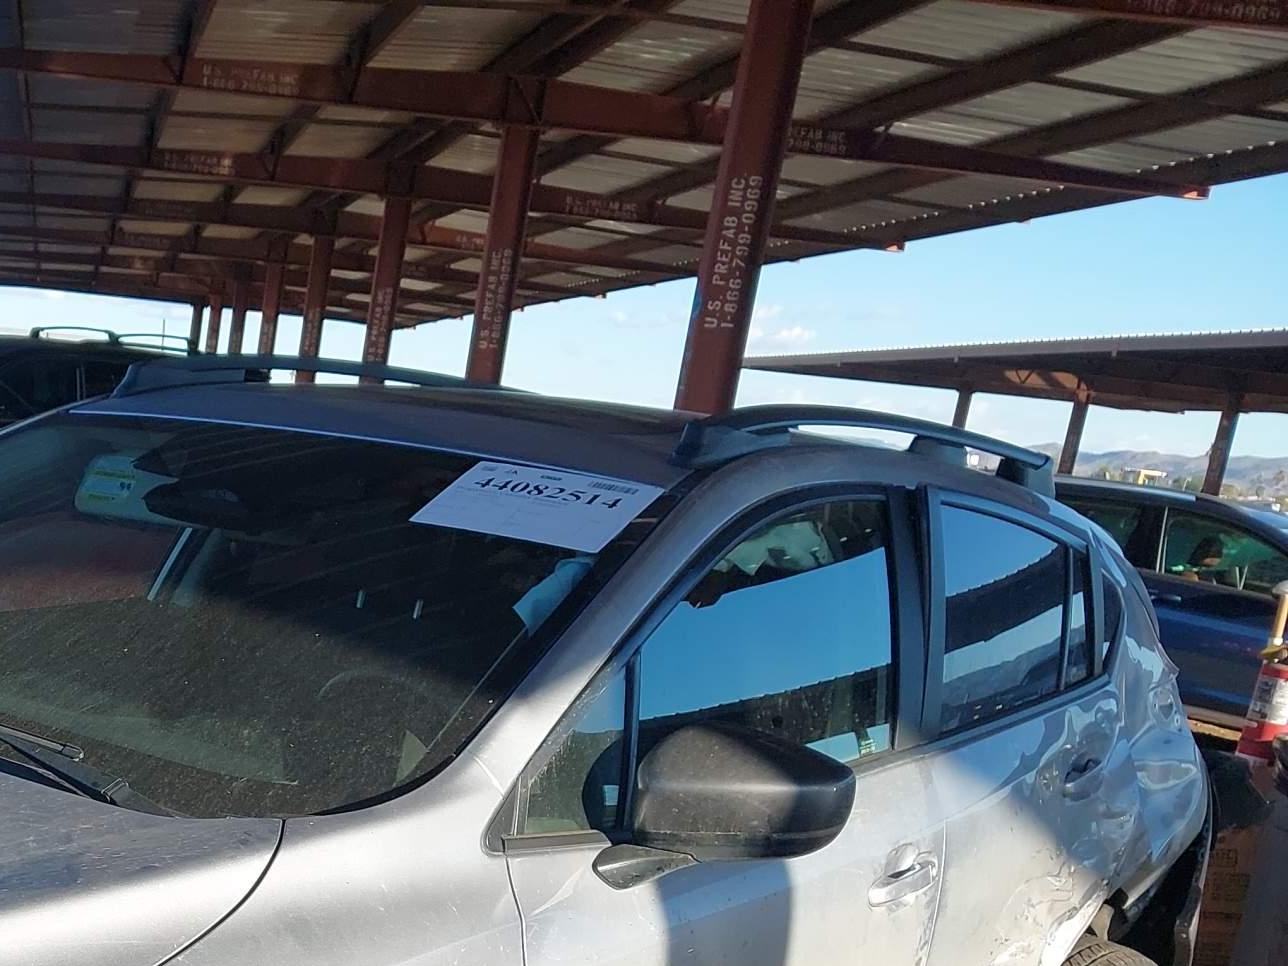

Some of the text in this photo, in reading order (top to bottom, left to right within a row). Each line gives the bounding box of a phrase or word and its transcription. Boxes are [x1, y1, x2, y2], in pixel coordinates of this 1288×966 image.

[712, 216, 738, 285] PREFAB
[721, 175, 763, 328] 1-866-799-0969
[704, 296, 723, 328] U.S.
[474, 476, 623, 509] 44082514
